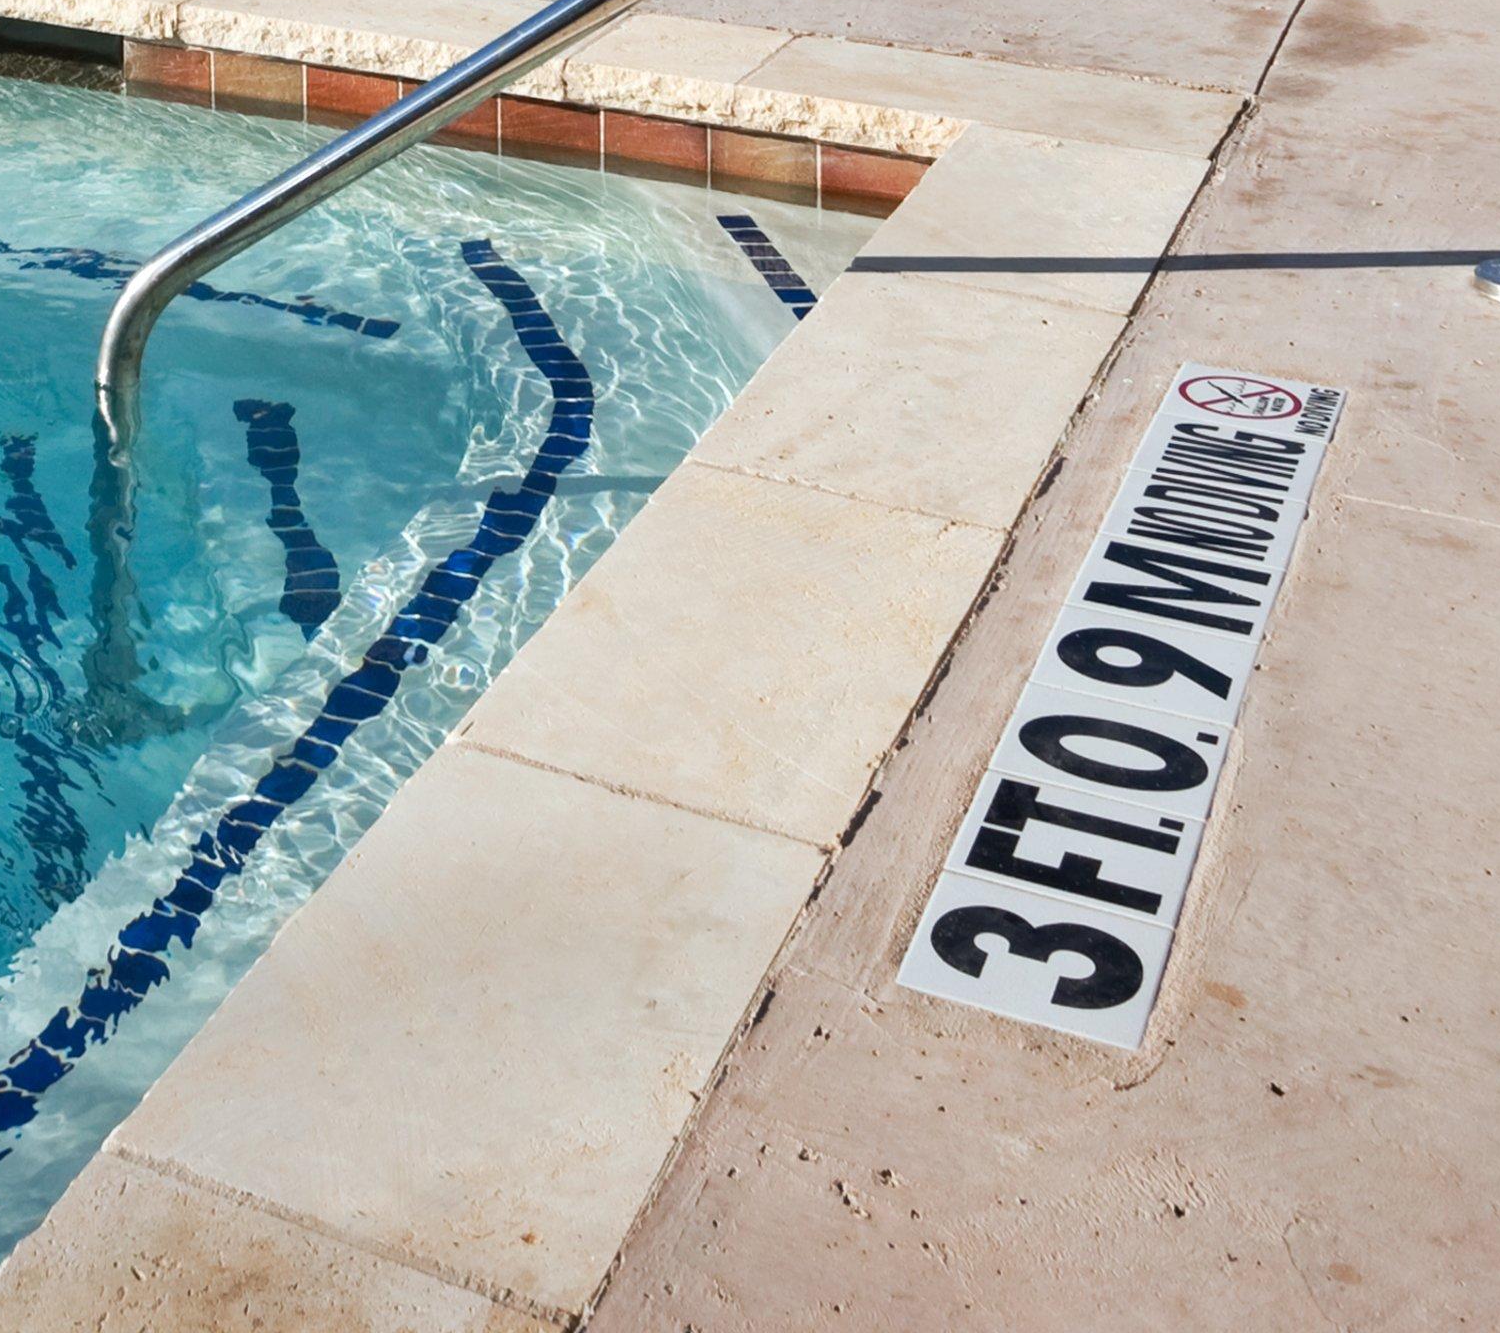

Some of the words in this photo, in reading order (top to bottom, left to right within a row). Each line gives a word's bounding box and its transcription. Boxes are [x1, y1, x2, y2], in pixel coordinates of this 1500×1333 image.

[1295, 420, 1329, 437] NO
[1301, 388, 1341, 422] DIVING
[1144, 422, 1306, 522] DIVING
[1127, 504, 1275, 562] NO
[1083, 540, 1272, 636] M
[930, 905, 1144, 1010] 3
